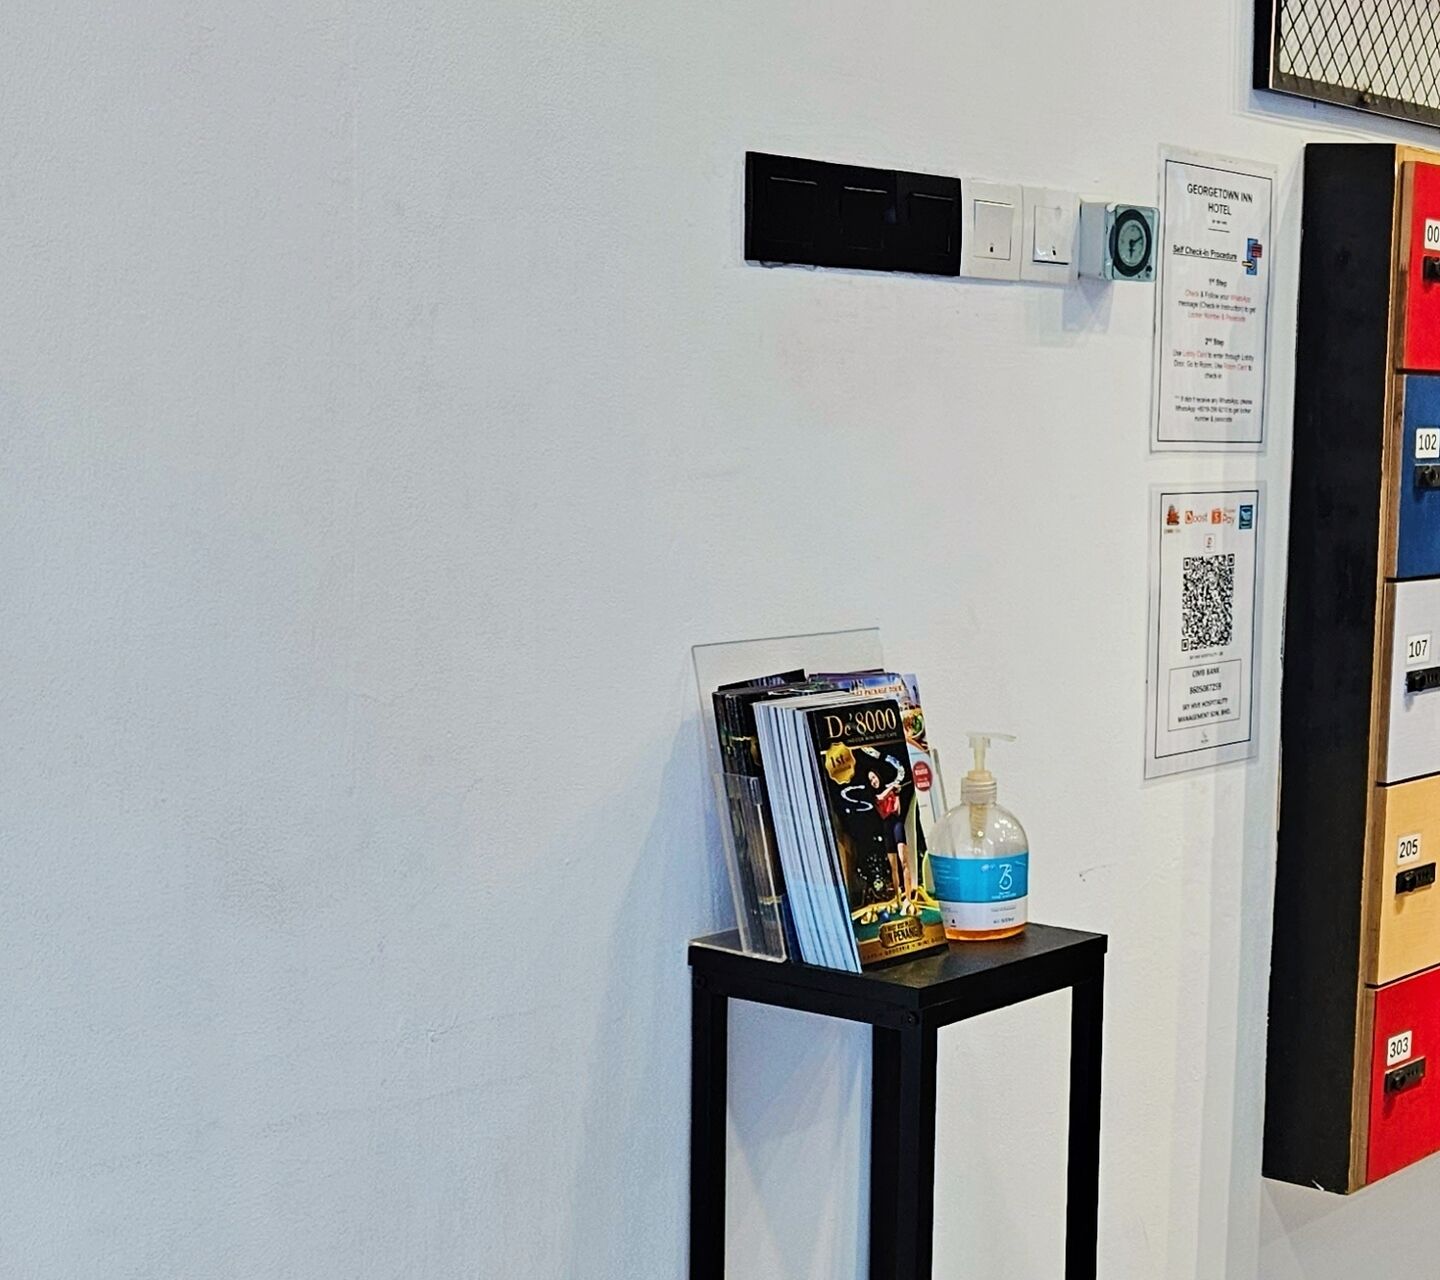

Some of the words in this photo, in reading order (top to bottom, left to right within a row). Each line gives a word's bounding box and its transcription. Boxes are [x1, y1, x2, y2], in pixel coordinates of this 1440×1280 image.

[1187, 183, 1239, 201] GEORGETOWN
[1241, 192, 1253, 203] INN
[1207, 202, 1232, 216] HOTEL
[1172, 244, 1184, 253] Self
[1418, 434, 1437, 451] 102
[1409, 639, 1428, 658] 107
[1399, 838, 1418, 858] 205
[1389, 1037, 1409, 1058] 303
